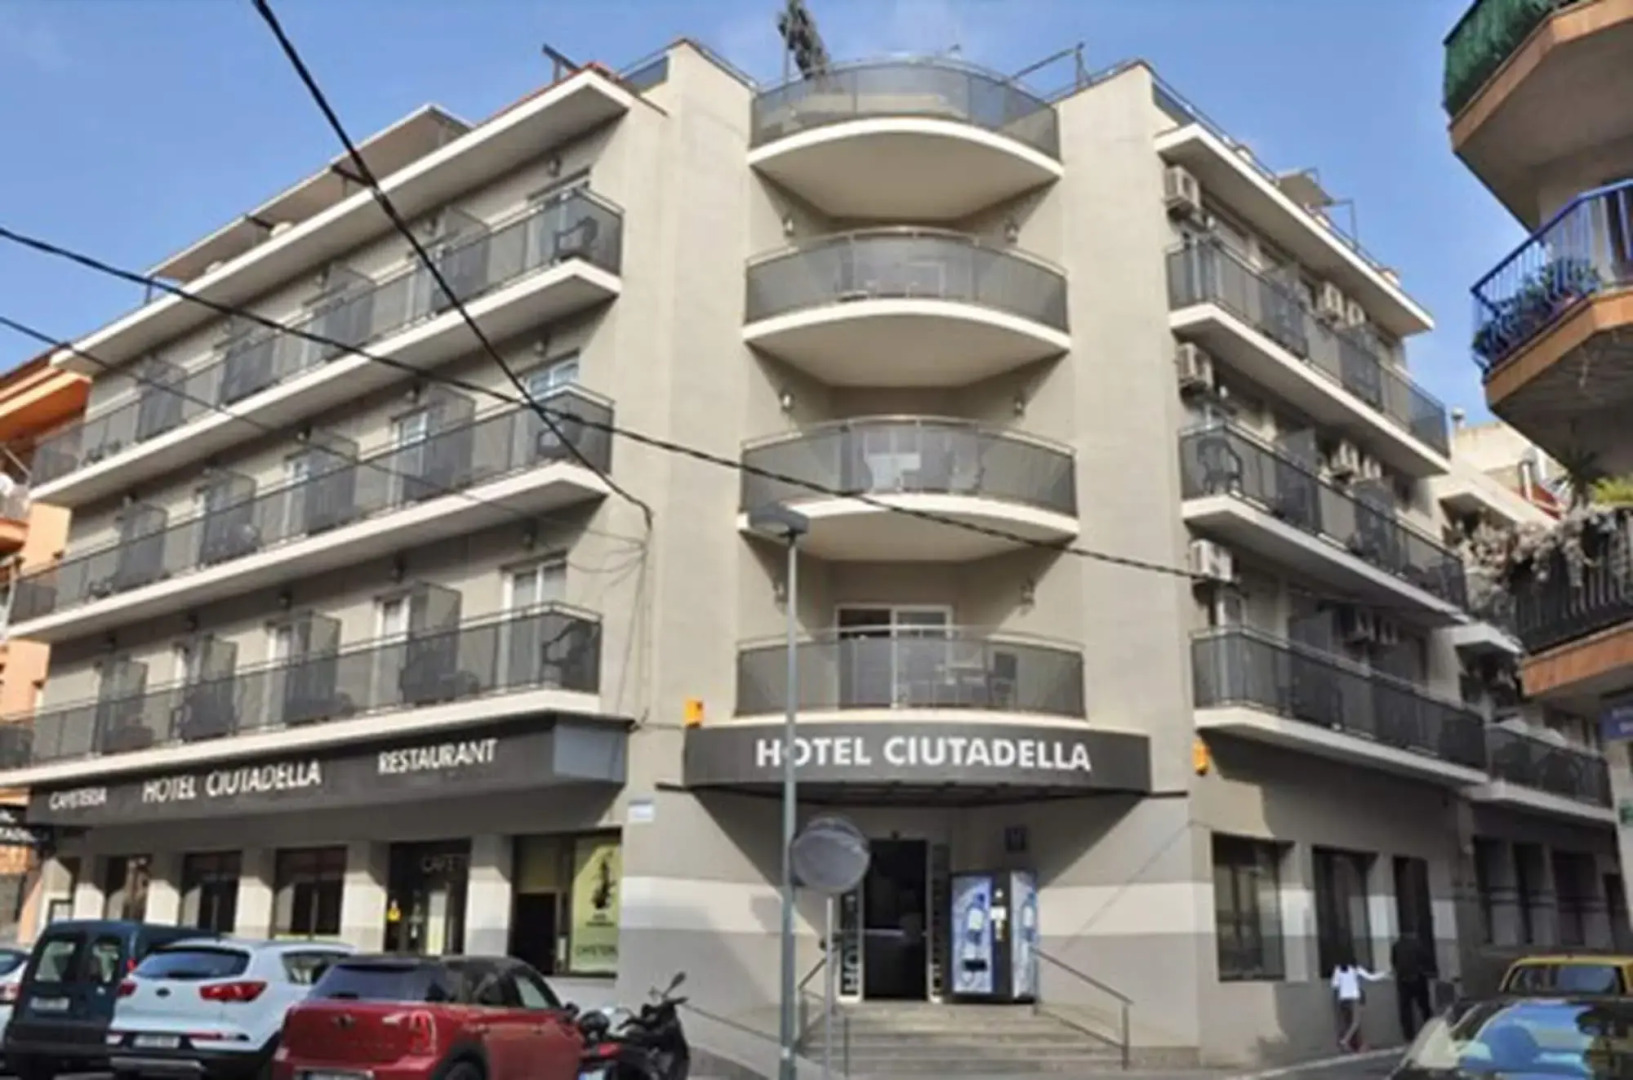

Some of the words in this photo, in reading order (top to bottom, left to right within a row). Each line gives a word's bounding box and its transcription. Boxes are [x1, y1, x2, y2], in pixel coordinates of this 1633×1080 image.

[378, 738, 498, 773] RESTAURANT
[756, 739, 871, 766] HOTEL
[884, 737, 1091, 771] CIUTADELLA
[142, 776, 196, 803] HOTEL
[206, 760, 321, 797] CIUTADELLA
